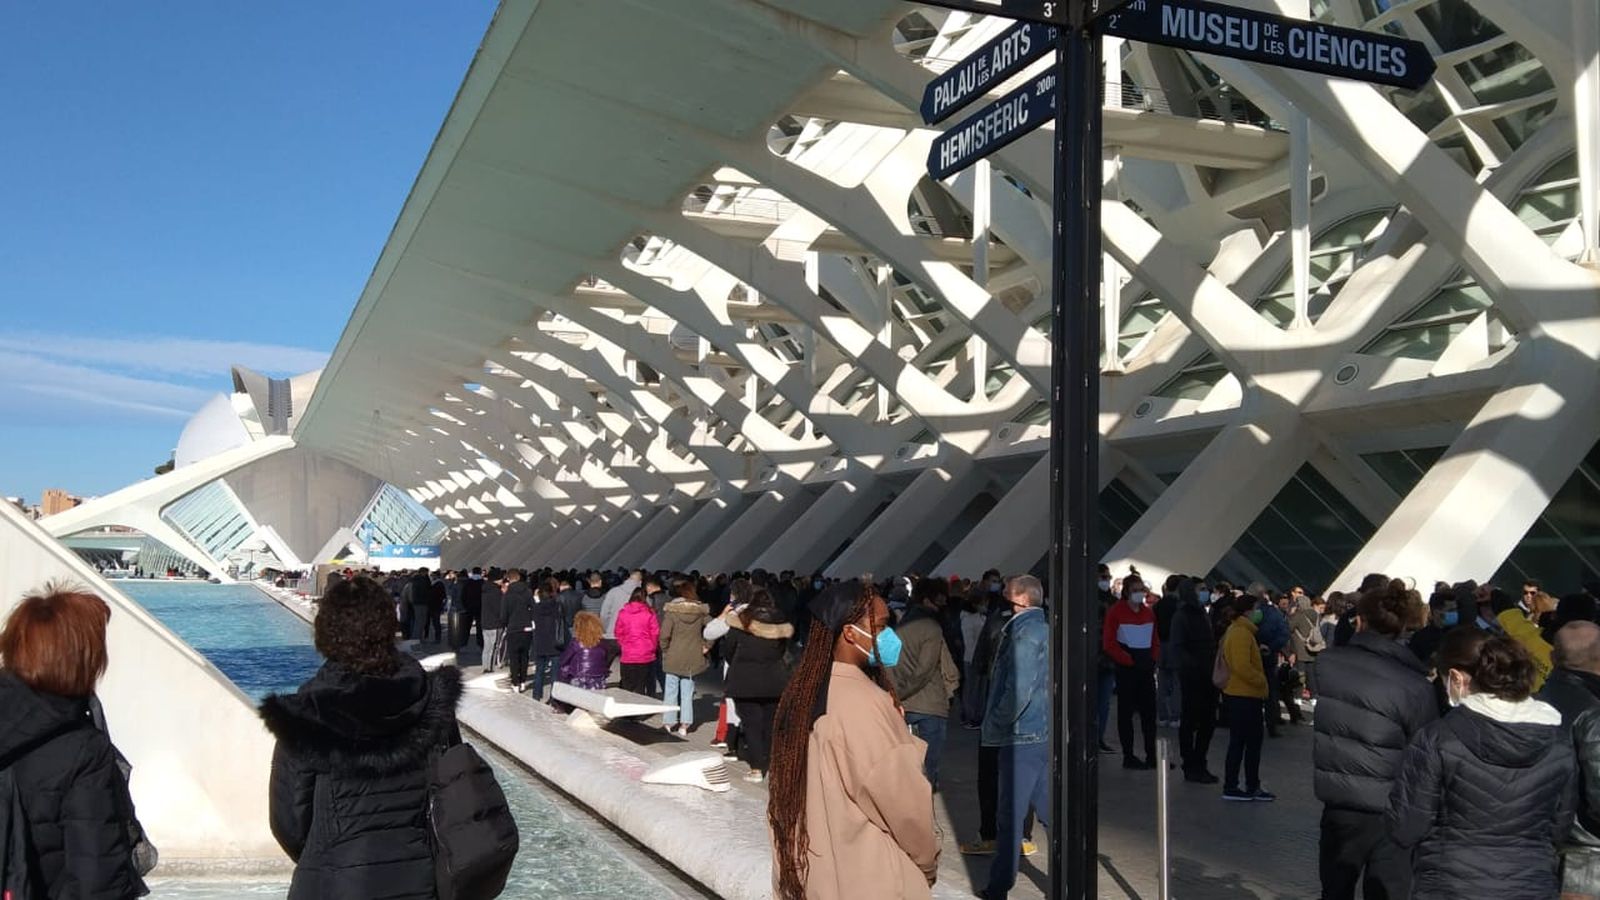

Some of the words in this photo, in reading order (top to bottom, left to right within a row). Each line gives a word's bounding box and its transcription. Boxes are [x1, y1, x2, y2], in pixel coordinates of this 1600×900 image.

[990, 23, 1031, 77] ARTS
[1161, 5, 1258, 51] MUSEU
[1263, 23, 1280, 39] DE
[1263, 39, 1285, 56] LES
[978, 54, 987, 71] DE
[1288, 26, 1408, 78] CIÈNCIES
[934, 62, 977, 116] PALAU
[977, 68, 990, 87] LES
[940, 92, 1029, 171] HEMISFÈRIC
